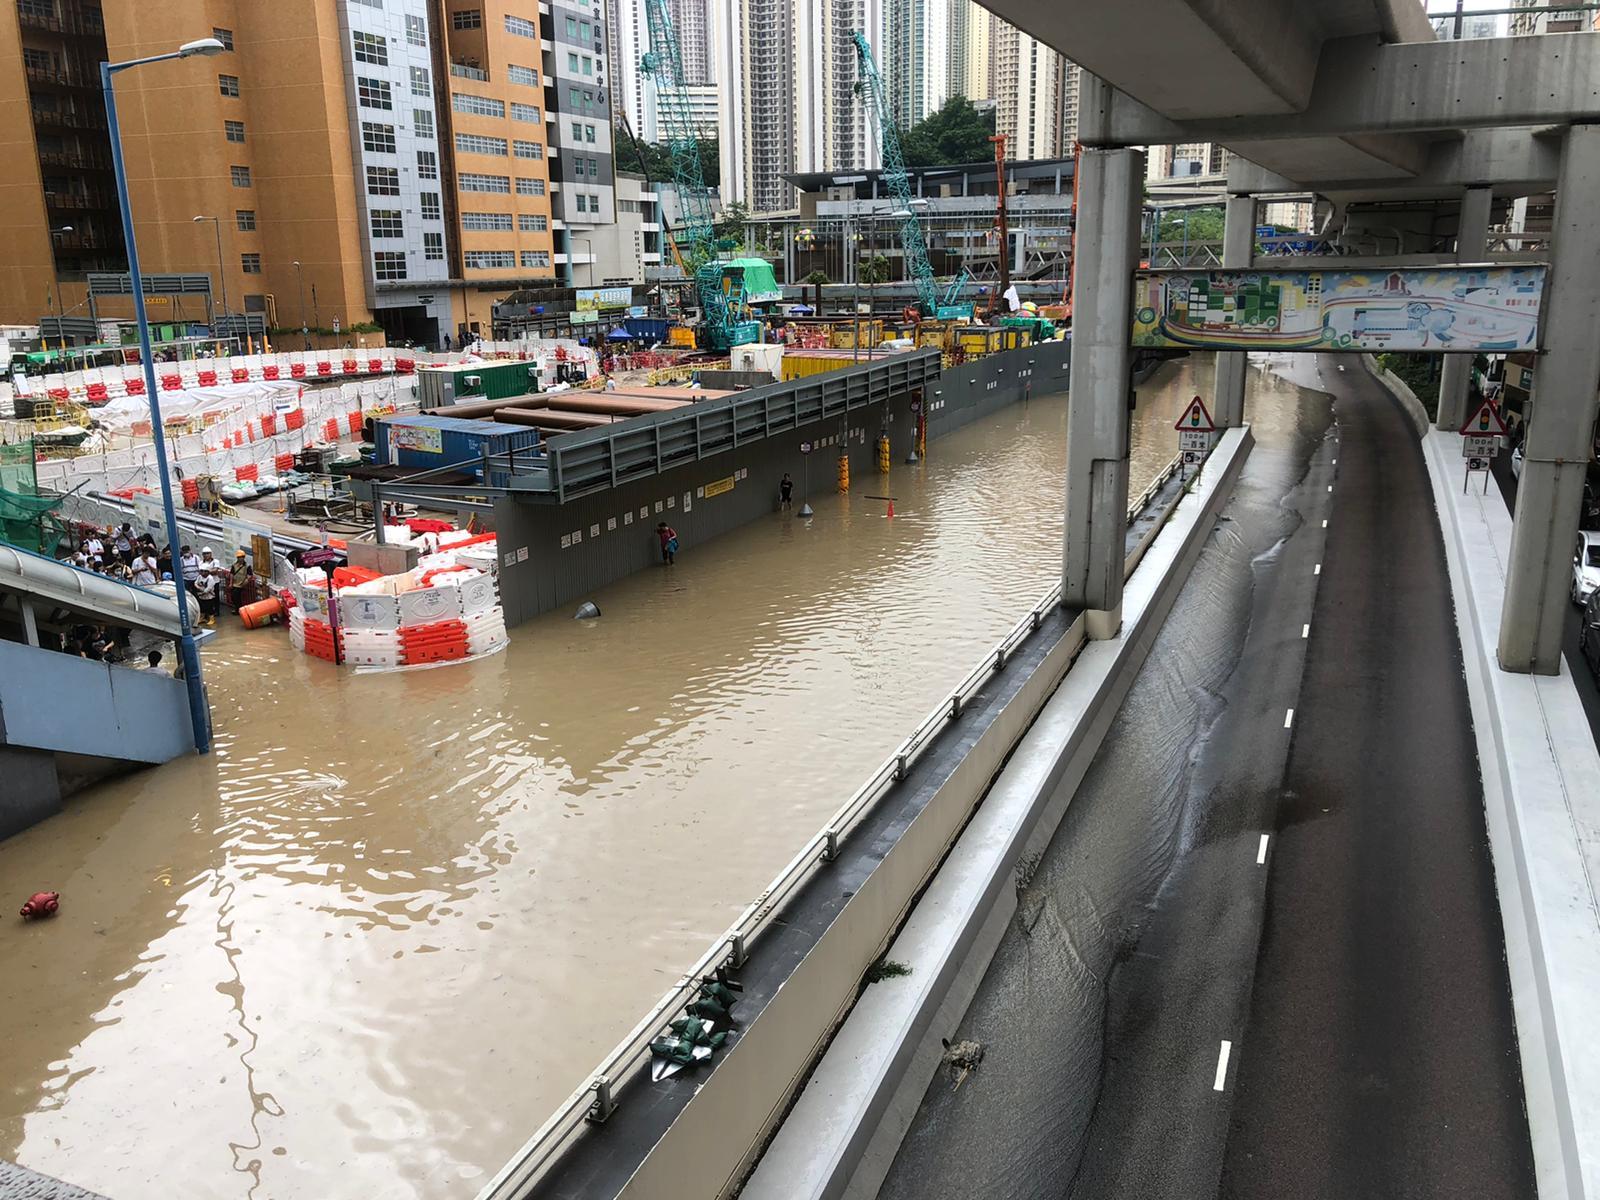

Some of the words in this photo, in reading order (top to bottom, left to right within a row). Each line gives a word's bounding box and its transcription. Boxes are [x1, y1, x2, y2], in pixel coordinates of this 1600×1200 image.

[1182, 441, 1206, 449] 一百米
[1466, 447, 1495, 455] 一百米
